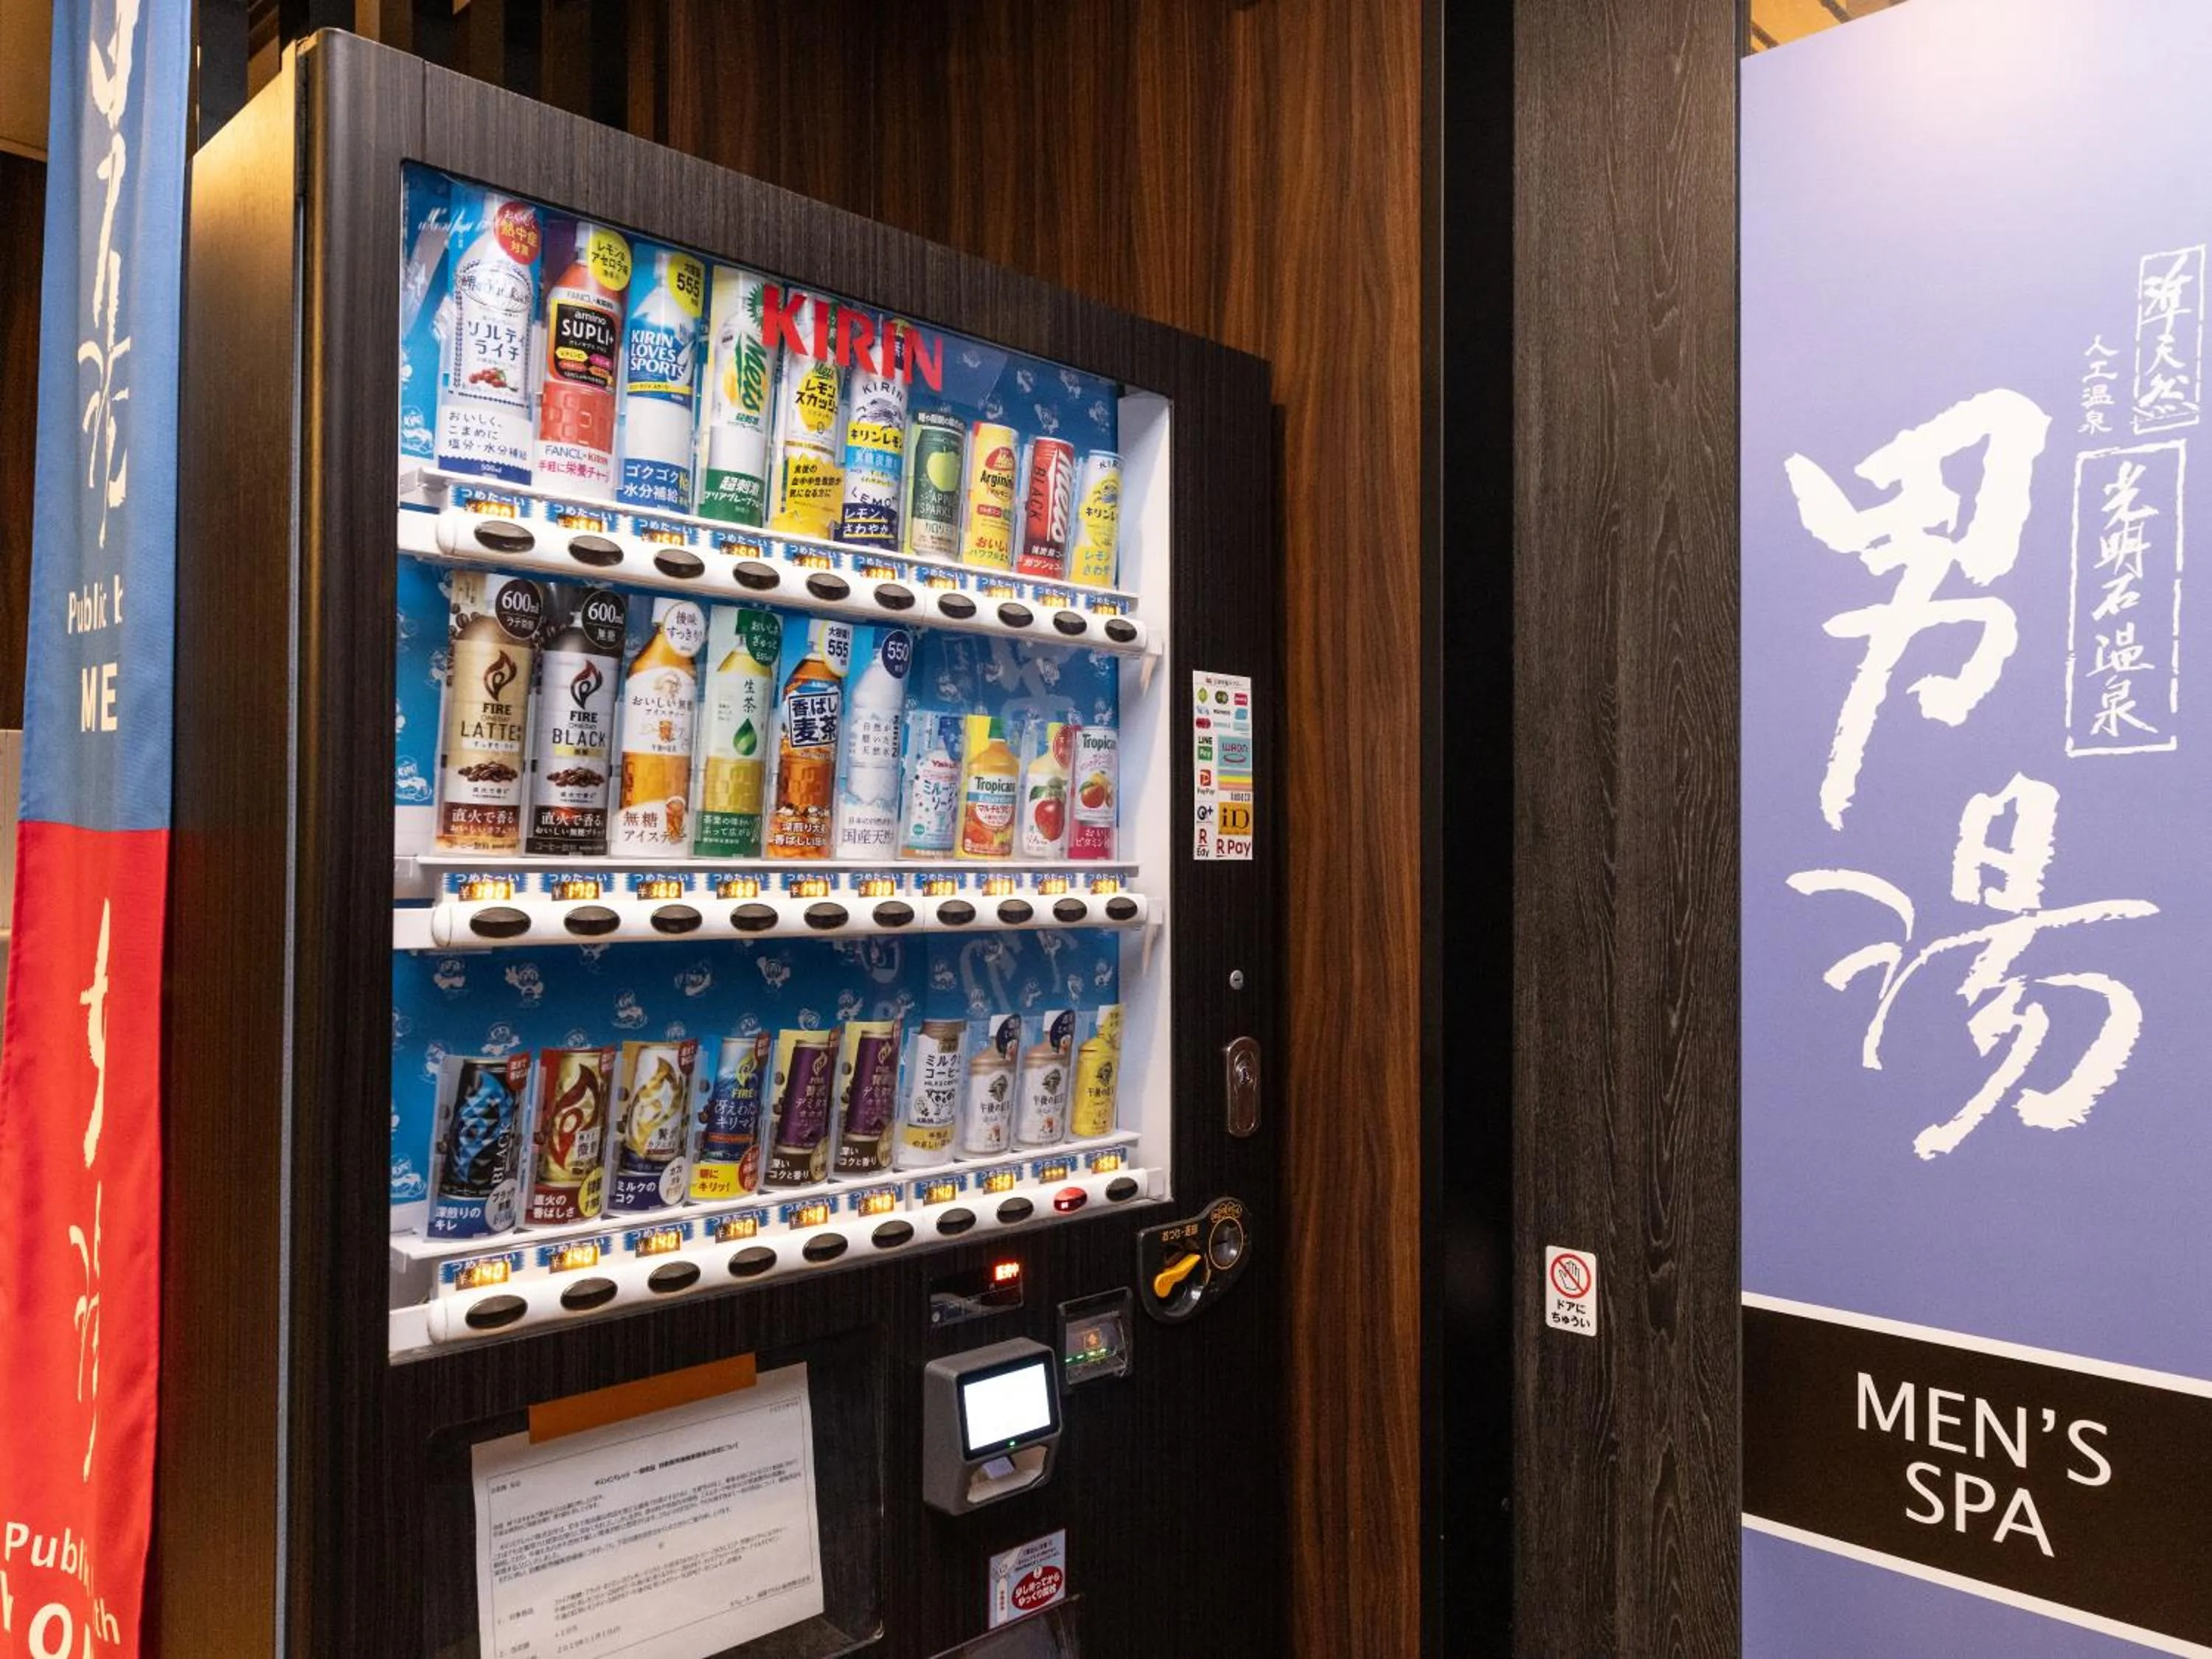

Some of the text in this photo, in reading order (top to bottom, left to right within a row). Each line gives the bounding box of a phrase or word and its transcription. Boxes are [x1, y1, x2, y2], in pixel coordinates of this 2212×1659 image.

[677, 273, 700, 297] 555
[574, 310, 607, 325] amino
[631, 330, 673, 349] KIRIN
[762, 283, 943, 392] KIRIN
[475, 339, 520, 361] ライチ
[630, 345, 676, 364] LOVES
[630, 357, 684, 379] SPORTS
[805, 380, 836, 399] レモン
[862, 382, 903, 401] KIRIN
[2078, 335, 2119, 435] 人工温泉
[448, 425, 499, 440] こまめに
[1030, 466, 1046, 522] BLACK
[2087, 461, 2158, 737] 光明石温泉
[827, 639, 849, 658] 555
[743, 678, 757, 713] 生茶
[483, 703, 512, 715] FIRE
[791, 697, 837, 717] 香ばし
[570, 711, 598, 723] FIRE
[461, 721, 518, 742] LATTE
[552, 728, 606, 748] BLACK
[793, 714, 837, 744] 麦茶
[1785, 389, 2159, 1161] 男湯
[452, 808, 514, 823] 直火で香る
[541, 813, 602, 827] 直火で香る
[624, 811, 658, 828] 無糖
[1222, 807, 1250, 830] iD
[1228, 839, 1251, 857] Pay
[492, 1124, 511, 1185] BLACK
[616, 1181, 656, 1192] ミルクの
[616, 1194, 635, 1203] コク
[435, 1220, 457, 1231] キレ
[1557, 1299, 1587, 1314] ドアに
[1551, 1311, 1590, 1328] ちゅうい
[1857, 1372, 2112, 1486] MEN'S
[1905, 1461, 2055, 1558] SPA
